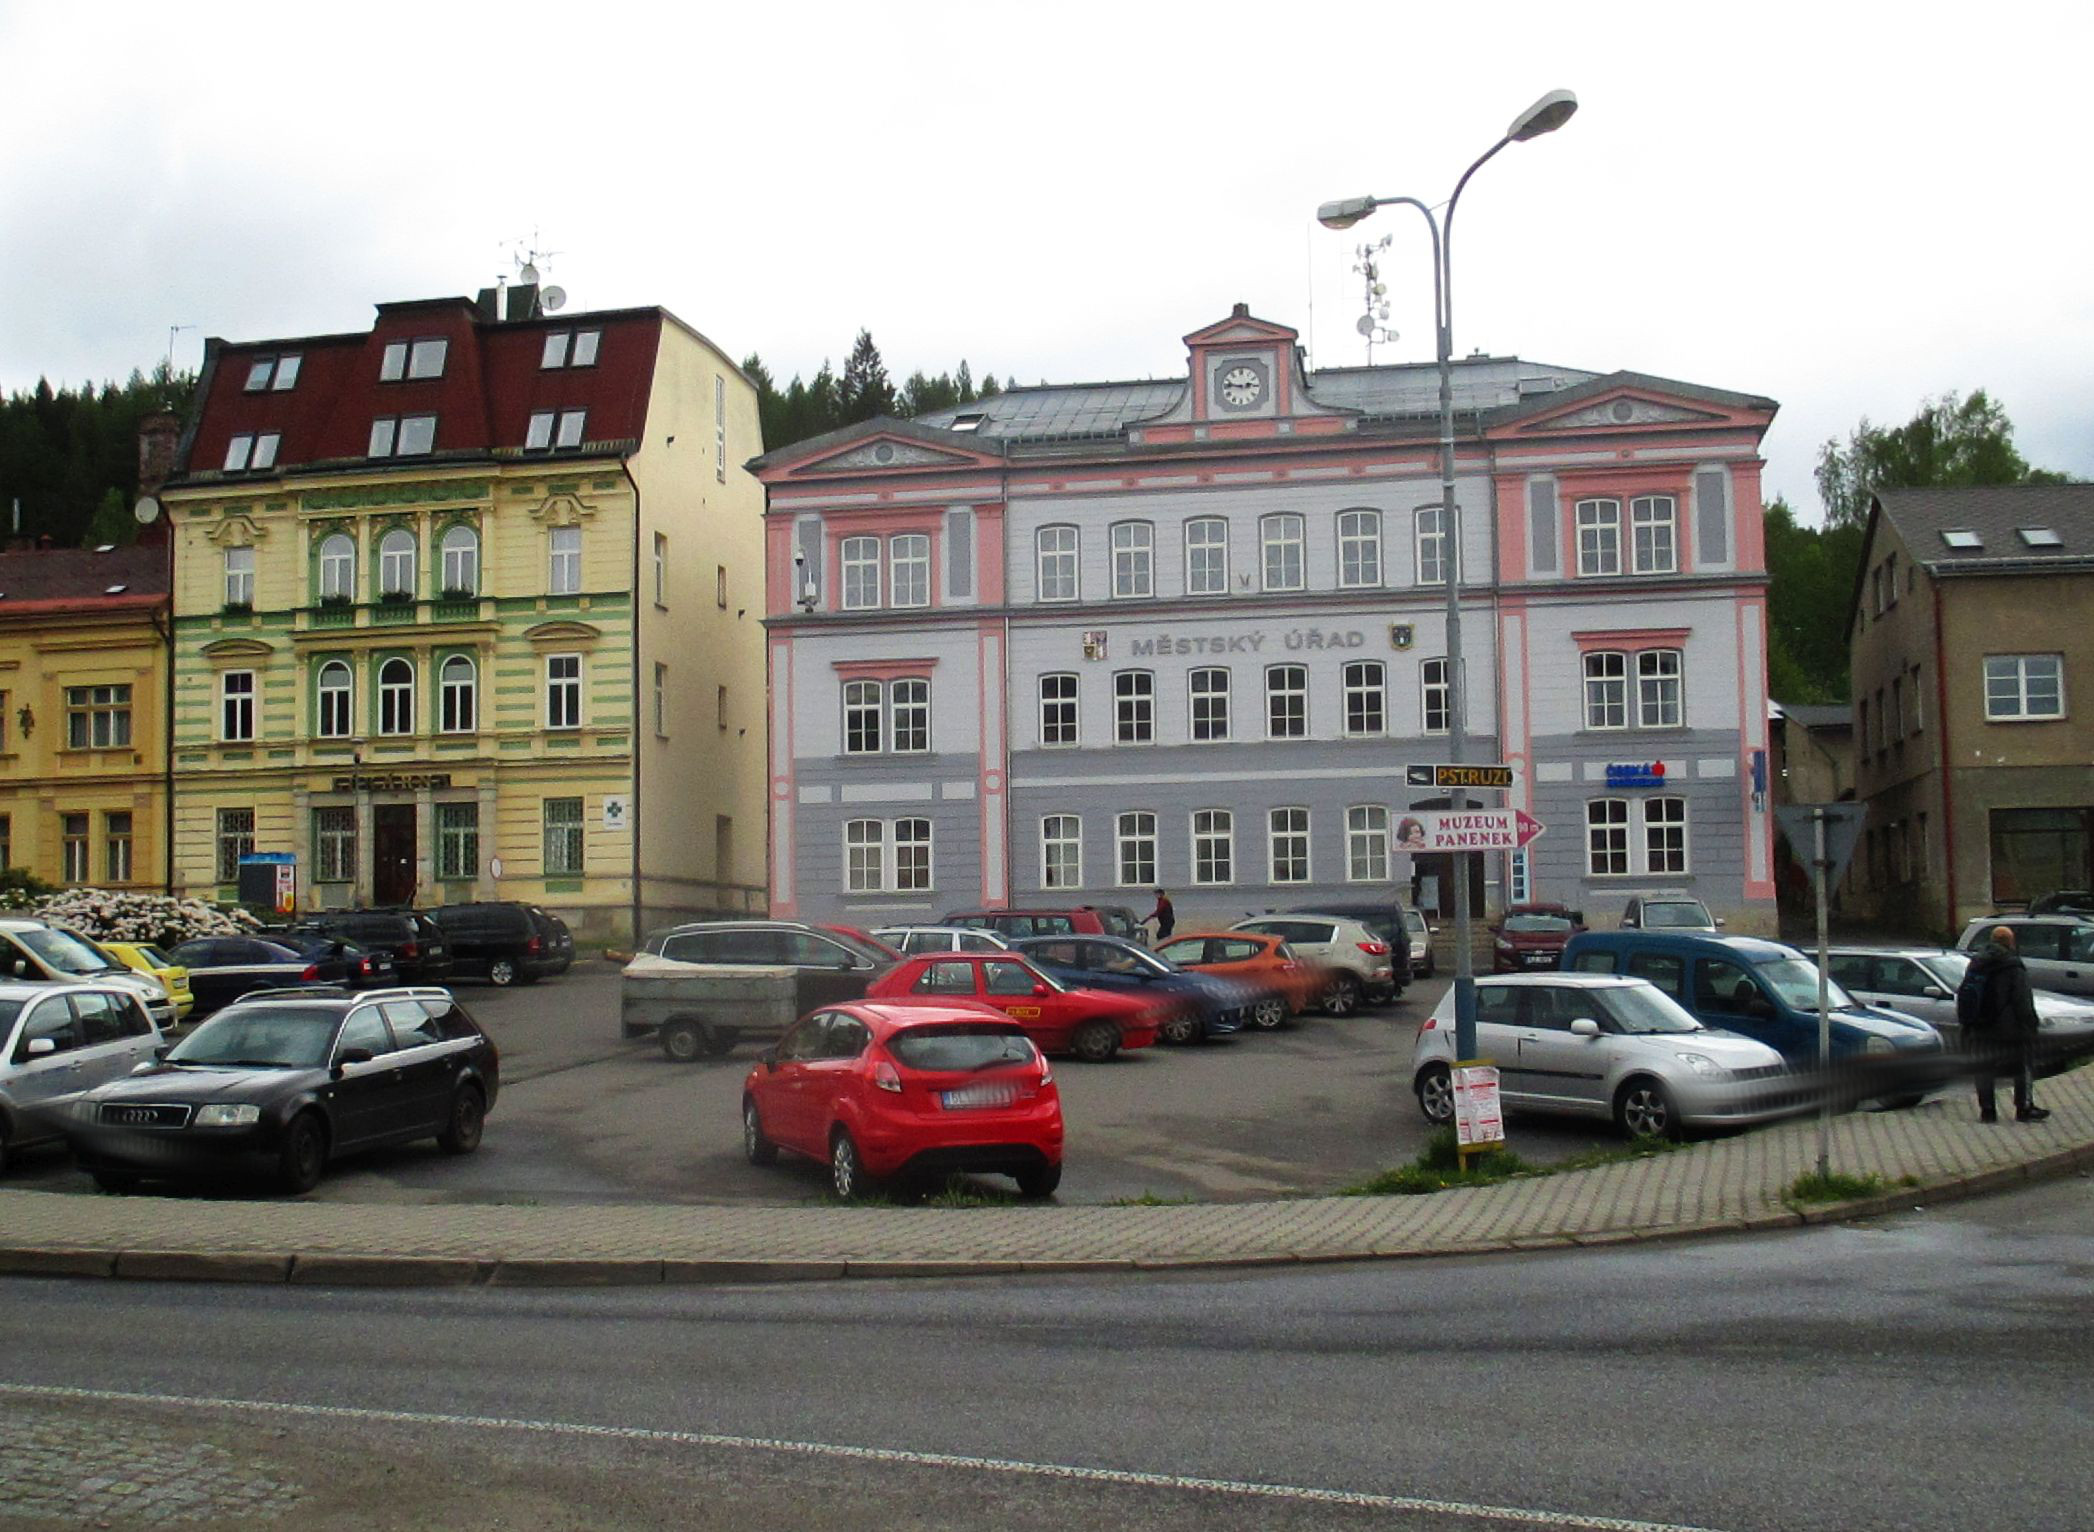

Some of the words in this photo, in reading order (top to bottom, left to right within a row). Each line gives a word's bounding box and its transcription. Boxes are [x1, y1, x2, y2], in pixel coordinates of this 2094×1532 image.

[1131, 630, 1266, 657] MĚSTSKÝ
[1284, 628, 1365, 651] ÚŘAD
[1439, 816, 1508, 831] MUZEUM
[1435, 832, 1513, 847] PANENEK
